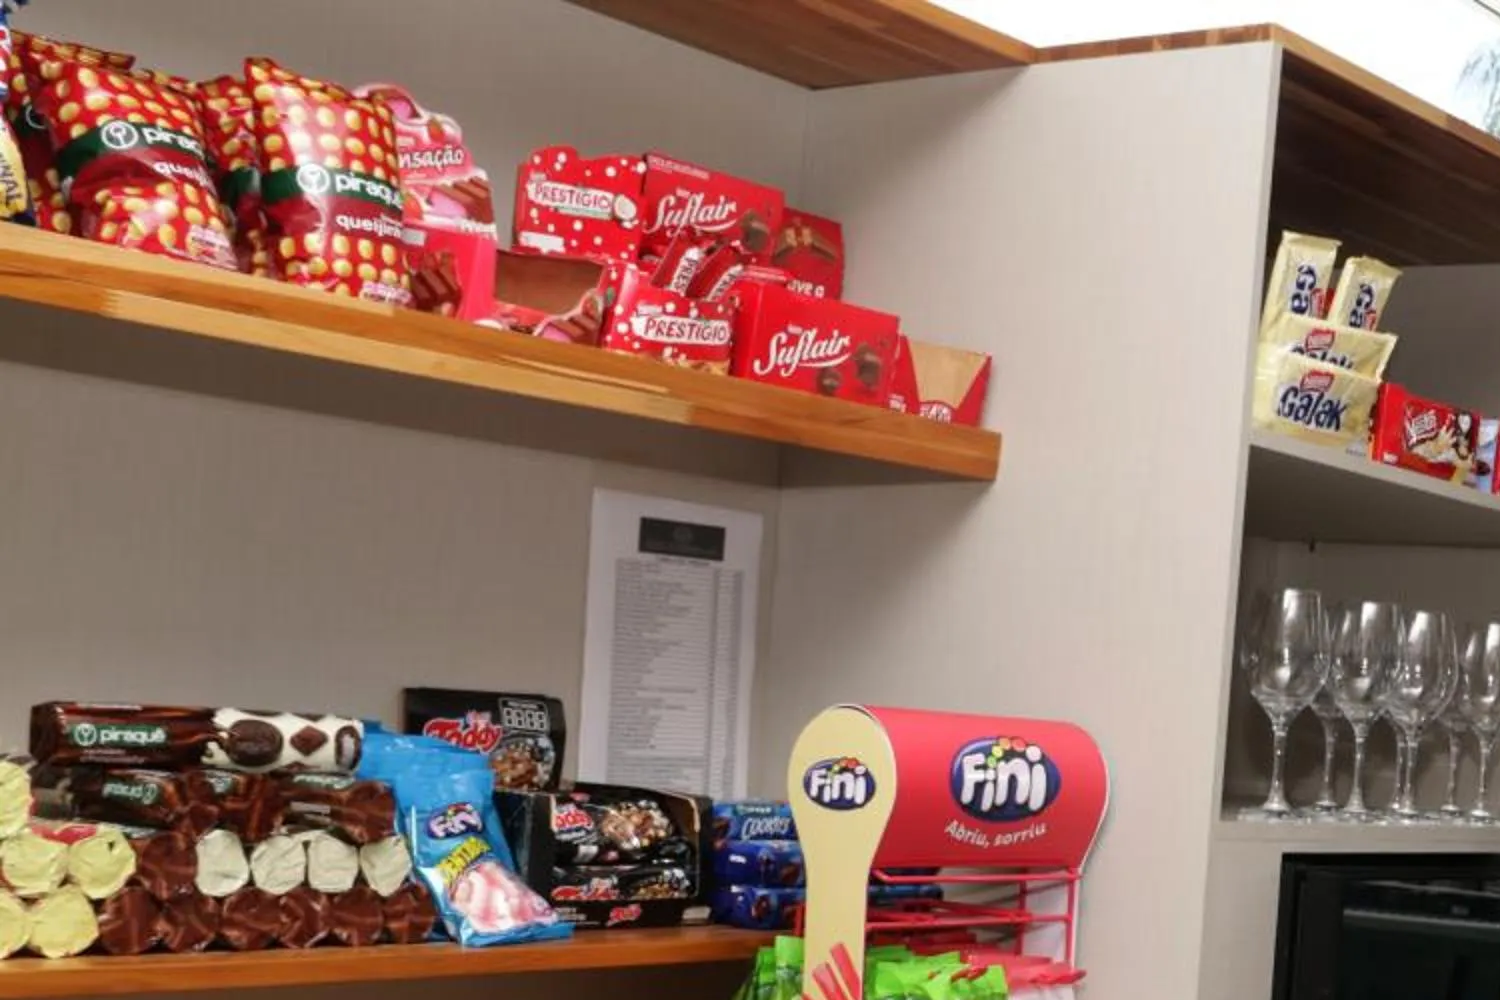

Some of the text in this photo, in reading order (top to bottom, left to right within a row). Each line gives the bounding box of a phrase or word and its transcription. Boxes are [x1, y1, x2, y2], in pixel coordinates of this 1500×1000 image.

[642, 318, 729, 344] PRESTIGIO
[753, 325, 853, 378] Suflair
[1278, 386, 1348, 432] Galak
[99, 724, 166, 746] piraquê
[809, 765, 867, 806] Fini
[960, 743, 1048, 812] Fini
